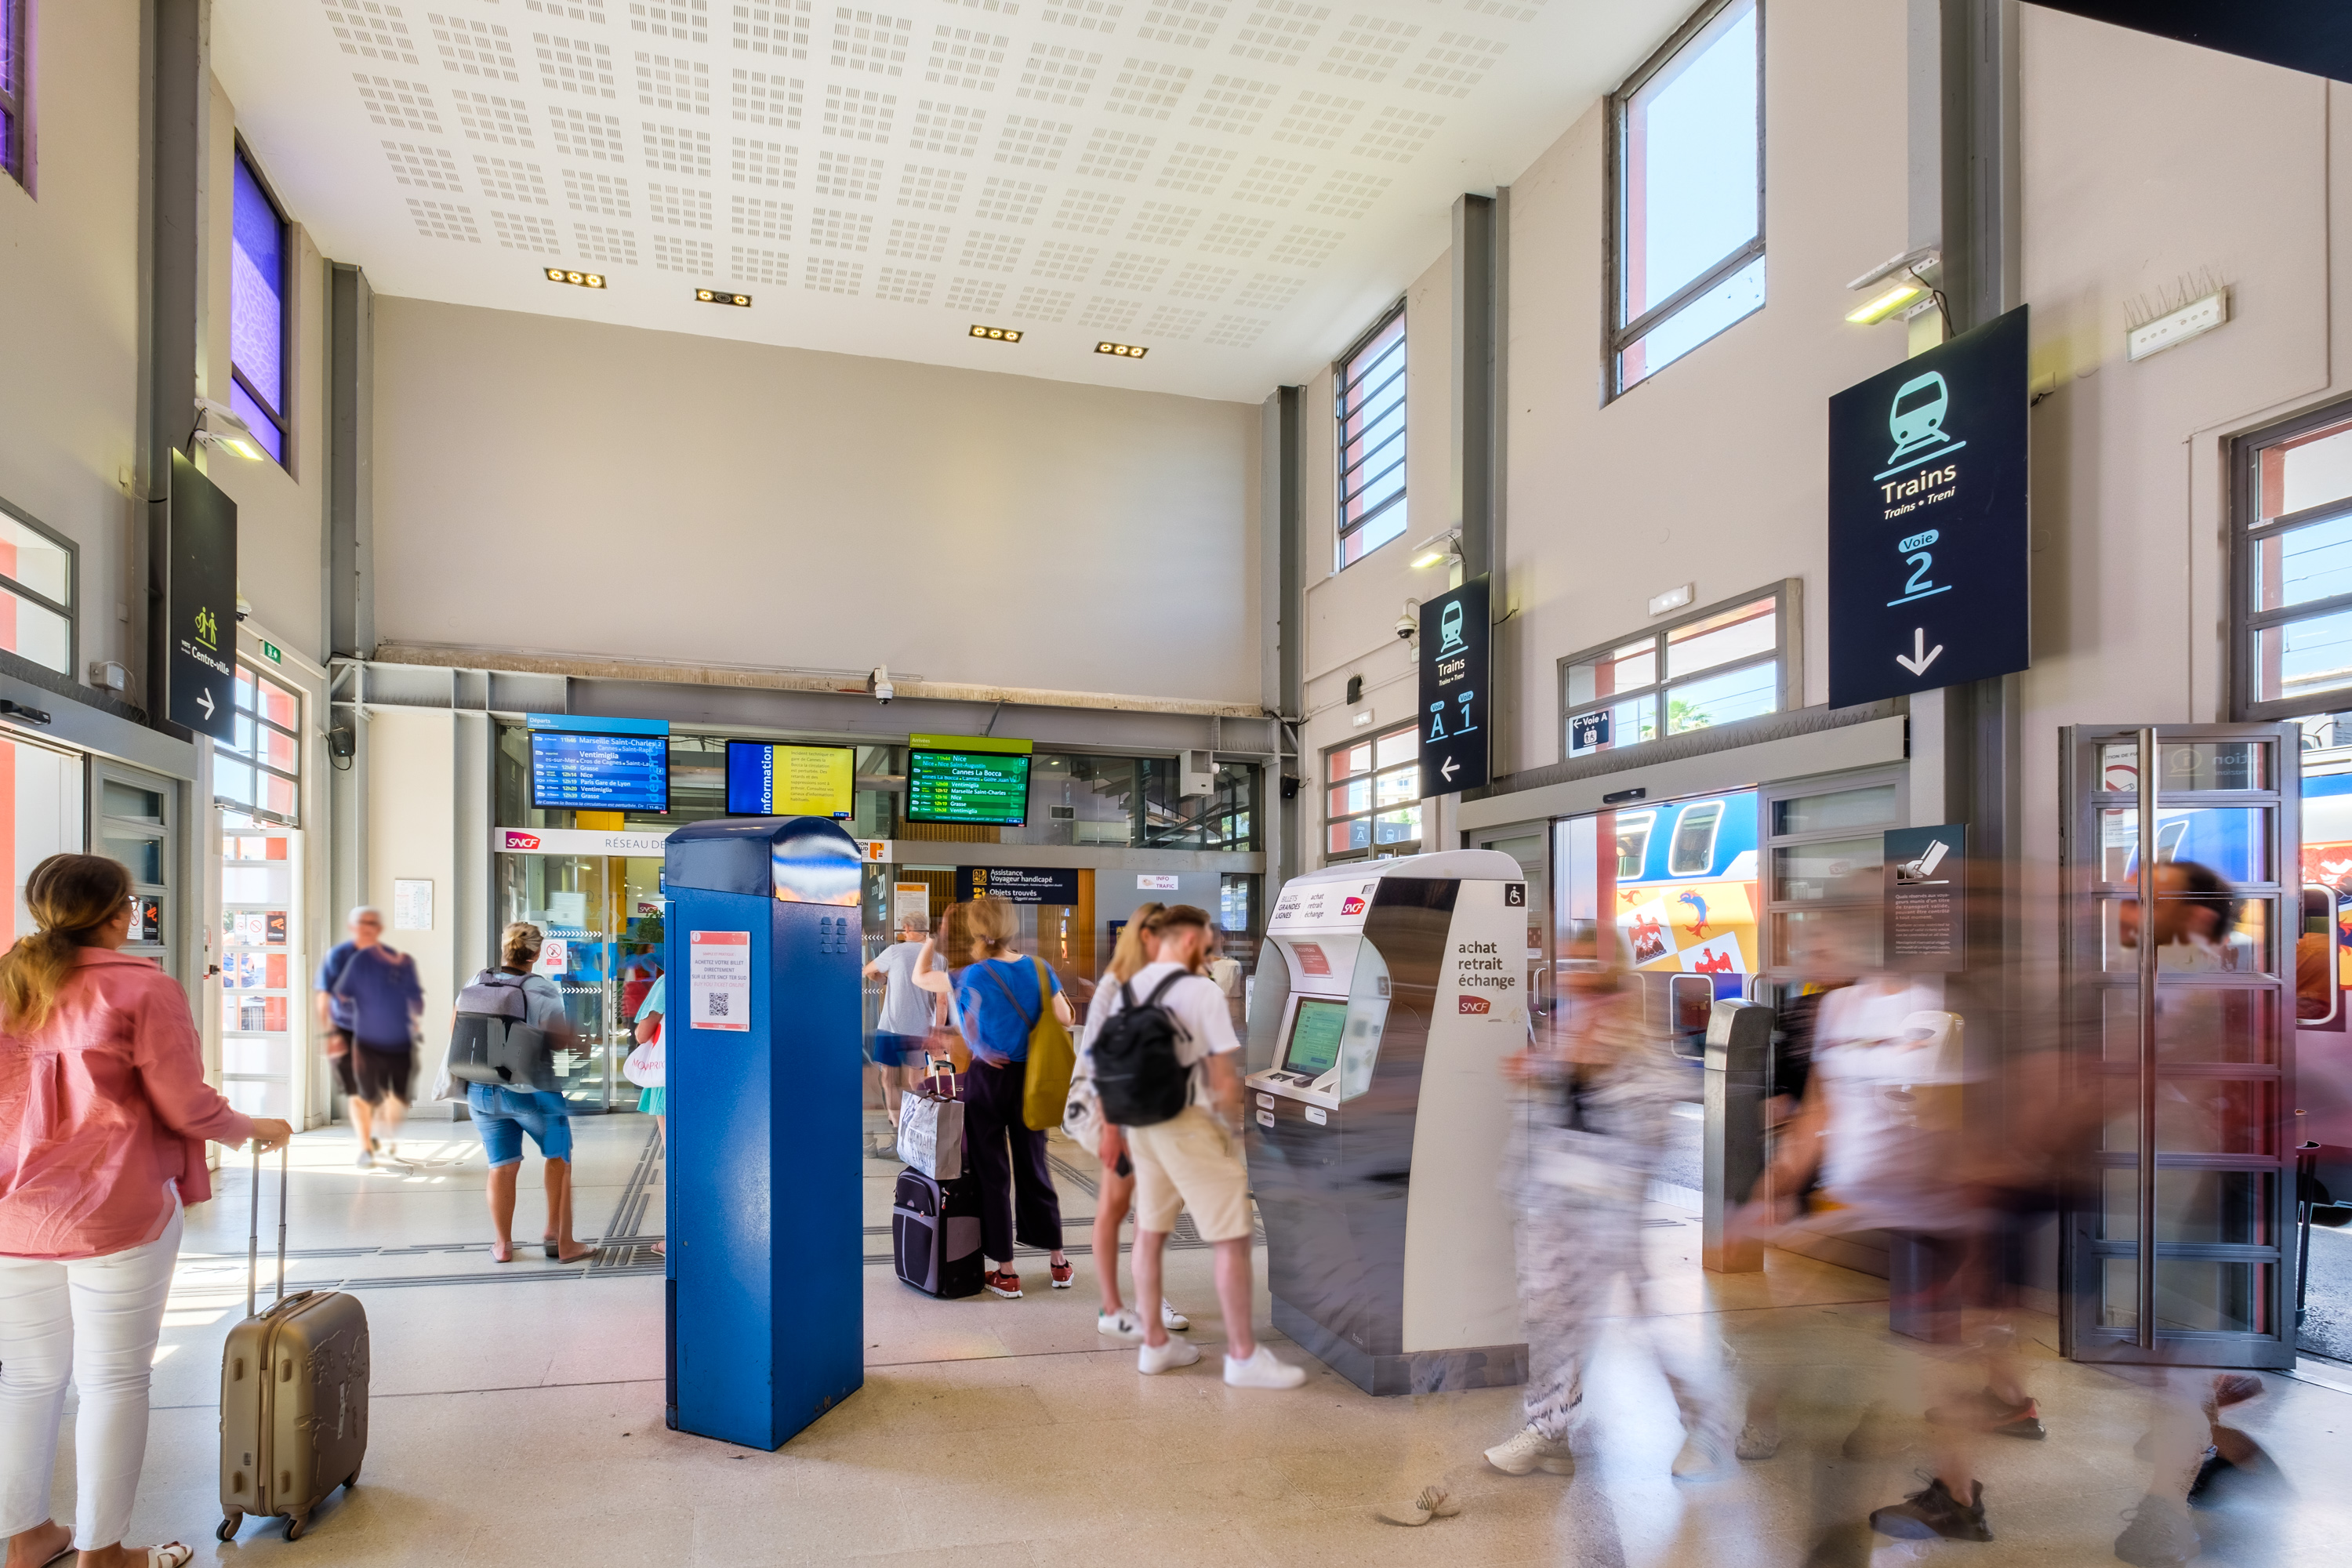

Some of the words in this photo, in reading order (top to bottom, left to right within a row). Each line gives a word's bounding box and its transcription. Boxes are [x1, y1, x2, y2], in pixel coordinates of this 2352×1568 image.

[1881, 464, 1956, 504] Trains
[1883, 500, 1916, 521] Trains
[1926, 486, 1956, 507] Treni
[1903, 532, 1934, 550] Voie
[1904, 551, 1933, 594] 2
[192, 646, 230, 676] Centre-ville
[1438, 658, 1465, 677] Trains
[1439, 677, 1451, 687] Trains
[1454, 672, 1465, 681] Treni
[1460, 692, 1472, 702] Voie
[1432, 702, 1443, 711] Voie
[1461, 702, 1470, 728] 1
[1583, 715, 1599, 726] Voie
[1601, 713, 1608, 721] A
[1430, 713, 1445, 738] A
[611, 739, 655, 747] Saint-Charles
[579, 751, 619, 760] Ventimiglia
[761, 746, 772, 815] information
[1356, 831, 1364, 840] A
[507, 838, 539, 848] SNCF
[605, 837, 648, 849] RÉSEAU
[1342, 903, 1364, 913] SNCF
[1458, 941, 1497, 953] achat
[1458, 957, 1503, 970] retrait
[1458, 974, 1515, 990] échange
[1461, 1003, 1489, 1012] SNCF
